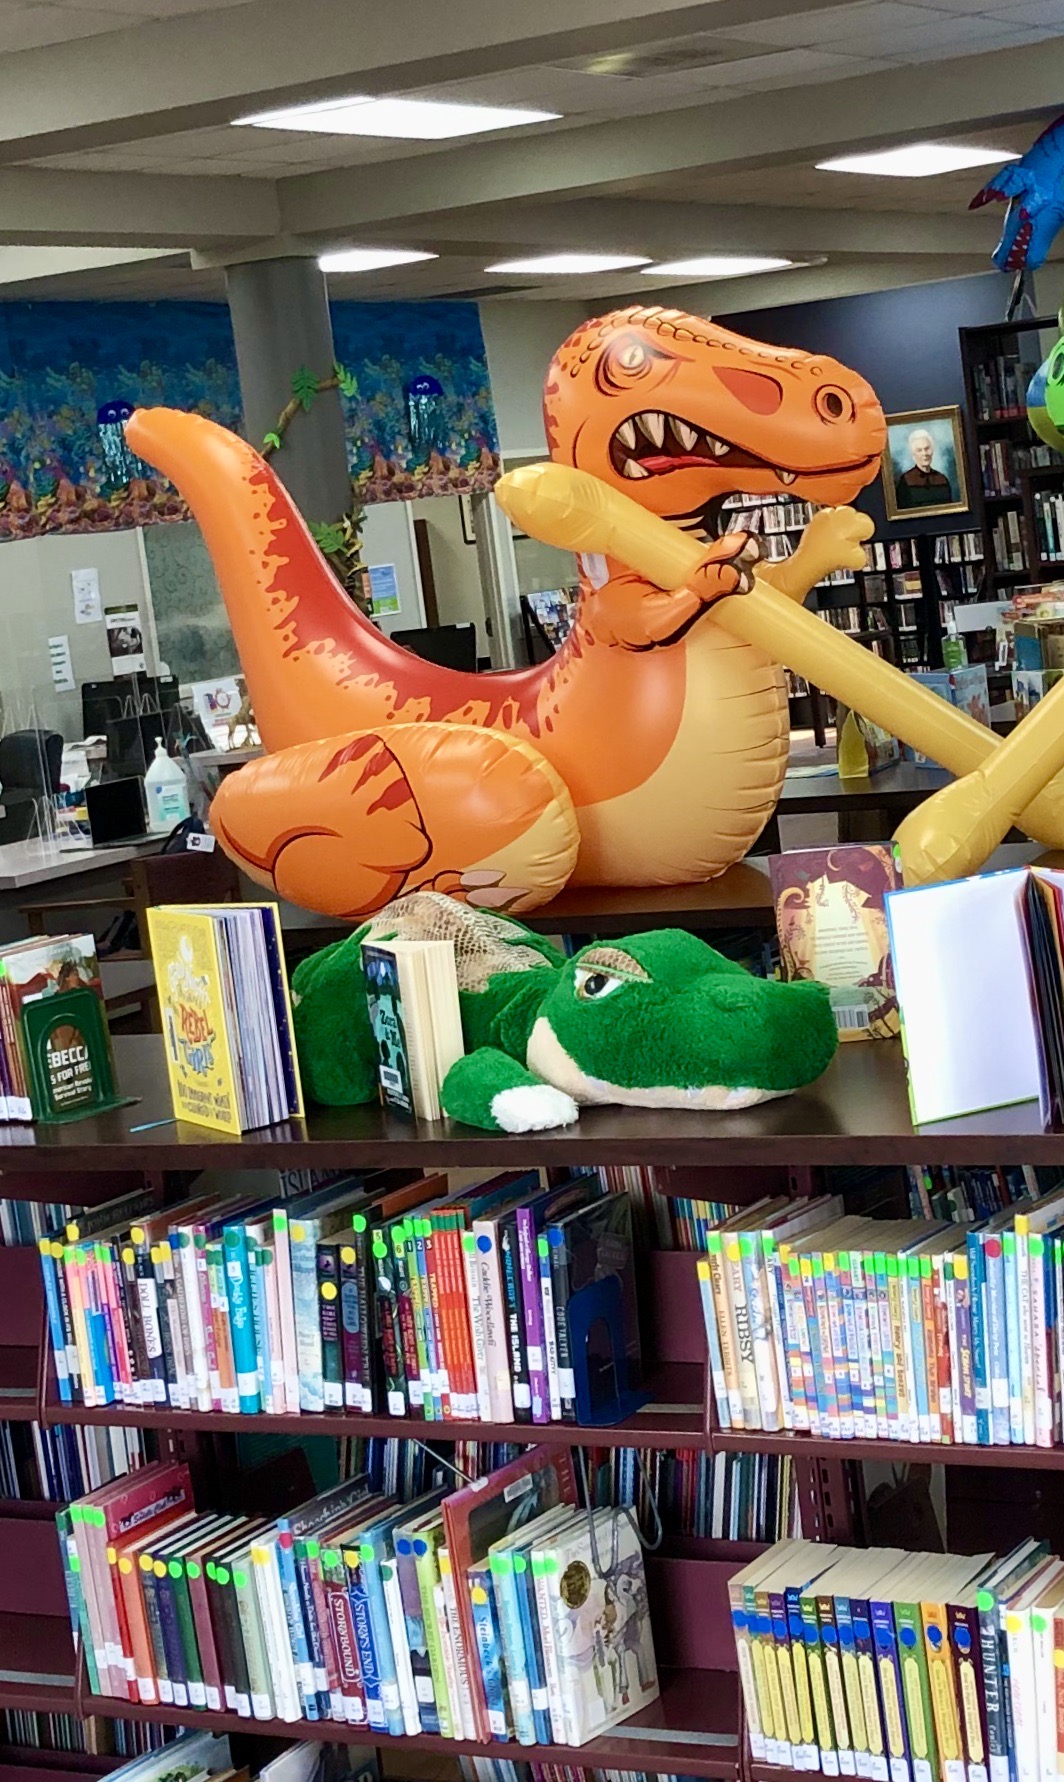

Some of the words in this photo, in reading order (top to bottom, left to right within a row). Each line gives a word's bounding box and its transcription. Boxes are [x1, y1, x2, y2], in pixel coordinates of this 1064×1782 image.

[179, 1004, 214, 1044] REBEL
[47, 1046, 89, 1069] BECC
[57, 1068, 73, 1082] FOR
[375, 1231, 381, 1241] 5
[416, 1240, 423, 1250] 2
[426, 1240, 432, 1249] 3
[481, 1262, 493, 1294] Caddie
[504, 1250, 516, 1309] MINECRAFT
[712, 1273, 721, 1295] Cleary
[730, 1261, 742, 1292] EARY
[139, 1283, 151, 1308] DOLL
[176, 1281, 188, 1324] GATHERING
[229, 1276, 244, 1304] Double
[430, 1272, 438, 1308] TRAPPED
[1021, 1288, 1029, 1303] CAT
[470, 1296, 480, 1312] The
[555, 1306, 565, 1327] CODE
[1032, 1291, 1040, 1338] SAHARA
[181, 1325, 189, 1335] OF
[234, 1307, 247, 1329] Fudge
[360, 1291, 369, 1354] HALLOWEEN
[472, 1314, 482, 1338] Wish
[484, 1294, 496, 1347] Woodlawn
[509, 1313, 519, 1332] THE
[719, 1310, 728, 1336] ELLEN
[142, 1315, 157, 1353] BONES
[182, 1336, 191, 1356] DAYS
[558, 1329, 568, 1358] TALKER
[735, 1303, 754, 1365] RIBSY
[893, 1325, 902, 1349] Henry
[475, 1339, 485, 1360] Giver
[511, 1334, 521, 1372] ISLAND
[722, 1341, 732, 1377] TEBBITS
[895, 1353, 904, 1367] and
[362, 1357, 370, 1380] TREE
[354, 1602, 372, 1648] STORY'S
[450, 1607, 458, 1624] THE
[334, 1598, 354, 1677] STORYBOUND
[479, 1617, 497, 1675] Steinbeck's
[362, 1650, 374, 1674] END
[452, 1626, 468, 1685] ENORMOUS
[981, 1639, 1000, 1713] HUNTER
